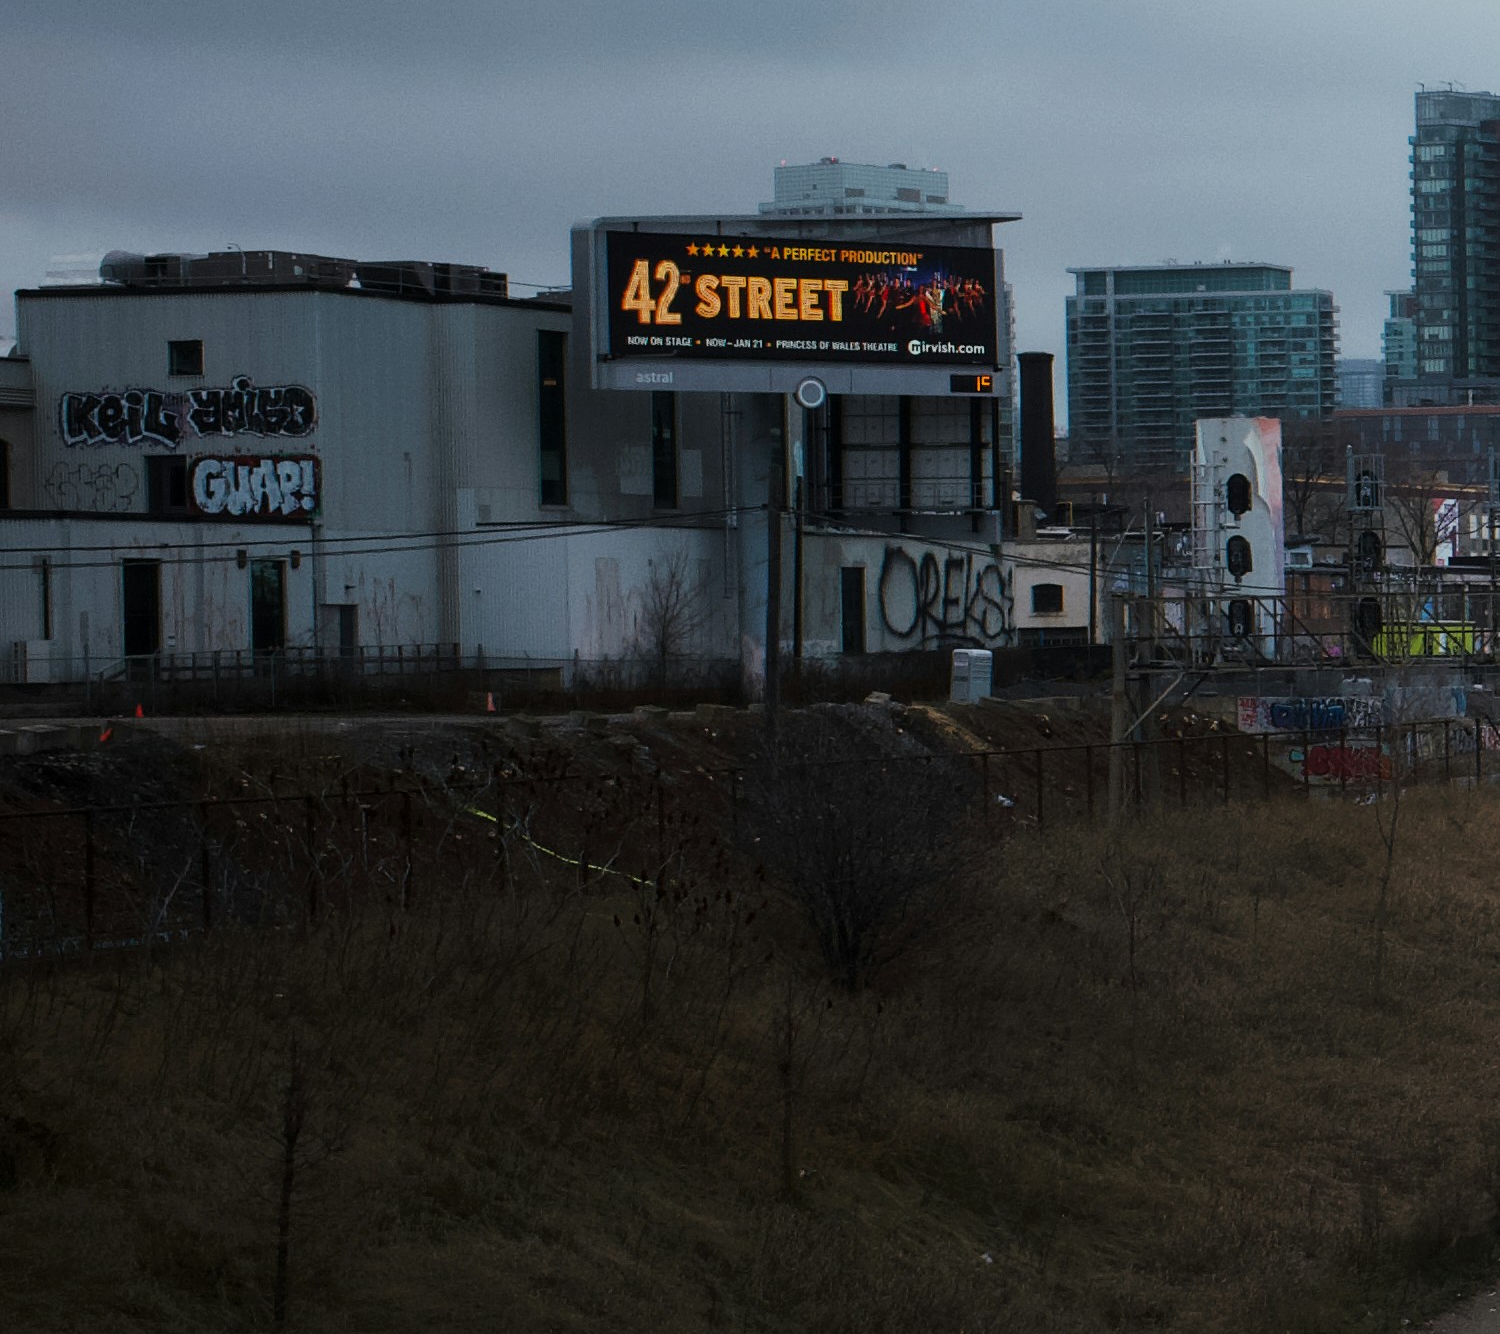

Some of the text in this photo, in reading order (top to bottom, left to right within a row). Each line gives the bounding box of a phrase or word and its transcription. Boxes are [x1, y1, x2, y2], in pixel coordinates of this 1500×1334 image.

[783, 247, 837, 262] PERFECT
[695, 274, 849, 322] STREET
[627, 336, 648, 346] NOW
[650, 336, 663, 346] ON
[665, 336, 693, 347] STAGE
[753, 339, 763, 349] 21
[776, 340, 817, 350] PRINCESS
[819, 341, 829, 350] OF
[832, 341, 861, 351] WALES
[863, 342, 898, 352] THEATRE
[636, 371, 673, 384] astral
